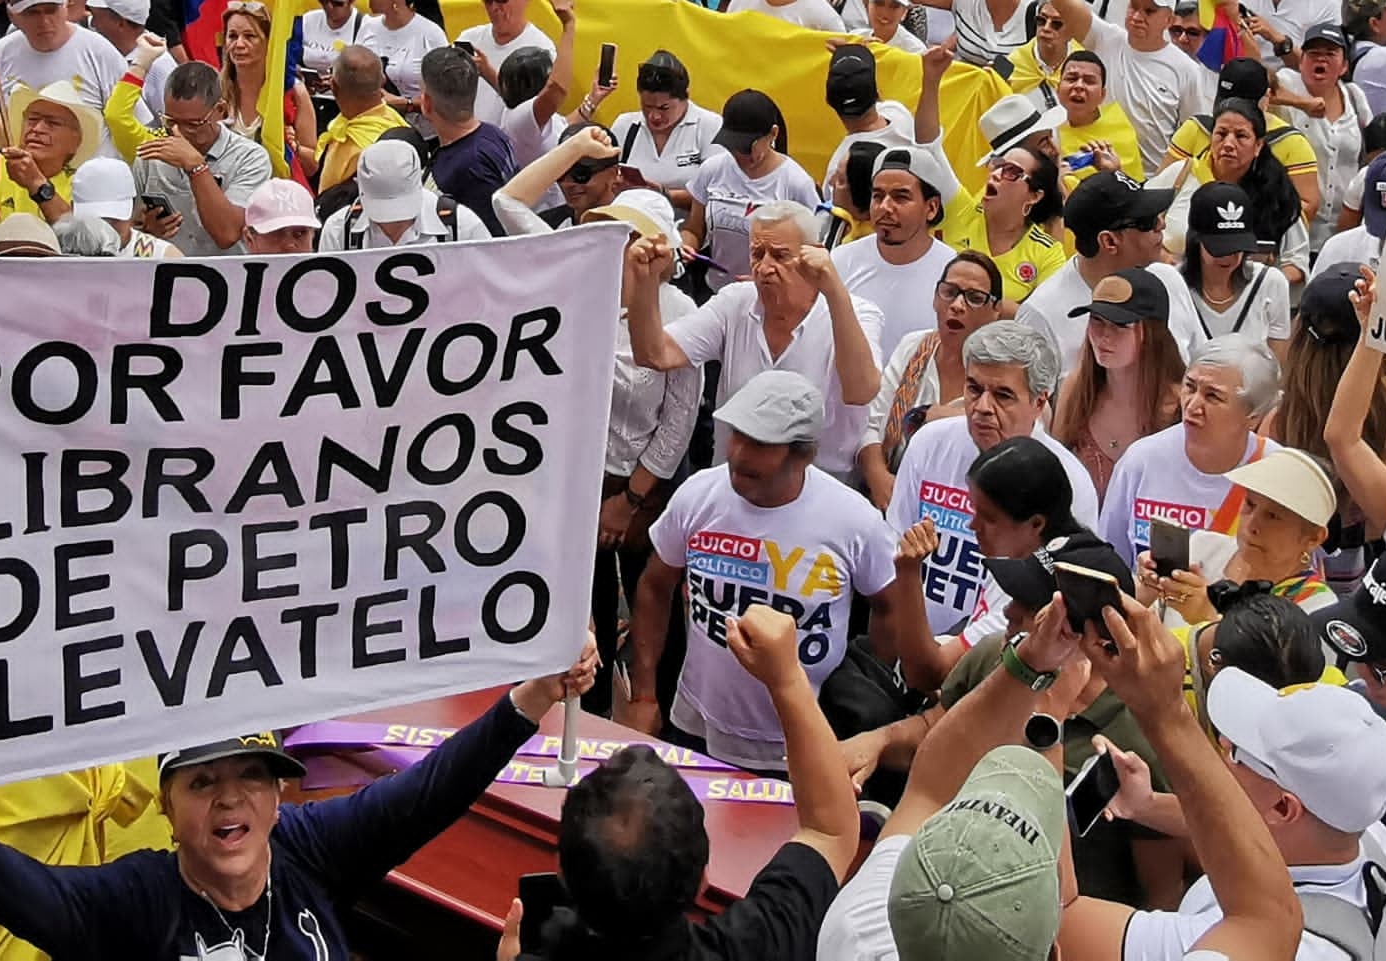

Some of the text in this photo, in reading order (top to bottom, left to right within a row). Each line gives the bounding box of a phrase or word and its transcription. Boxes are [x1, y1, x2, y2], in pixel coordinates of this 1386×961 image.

[149, 251, 436, 339] DIOS
[219, 306, 563, 420] FAVOR
[923, 485, 976, 514] JUCI
[1136, 501, 1202, 526] JUICIO
[167, 490, 527, 612] PETRO
[690, 534, 843, 598] JUICIO YA
[691, 598, 830, 666] PEO
[541, 736, 698, 766] PNSAL
